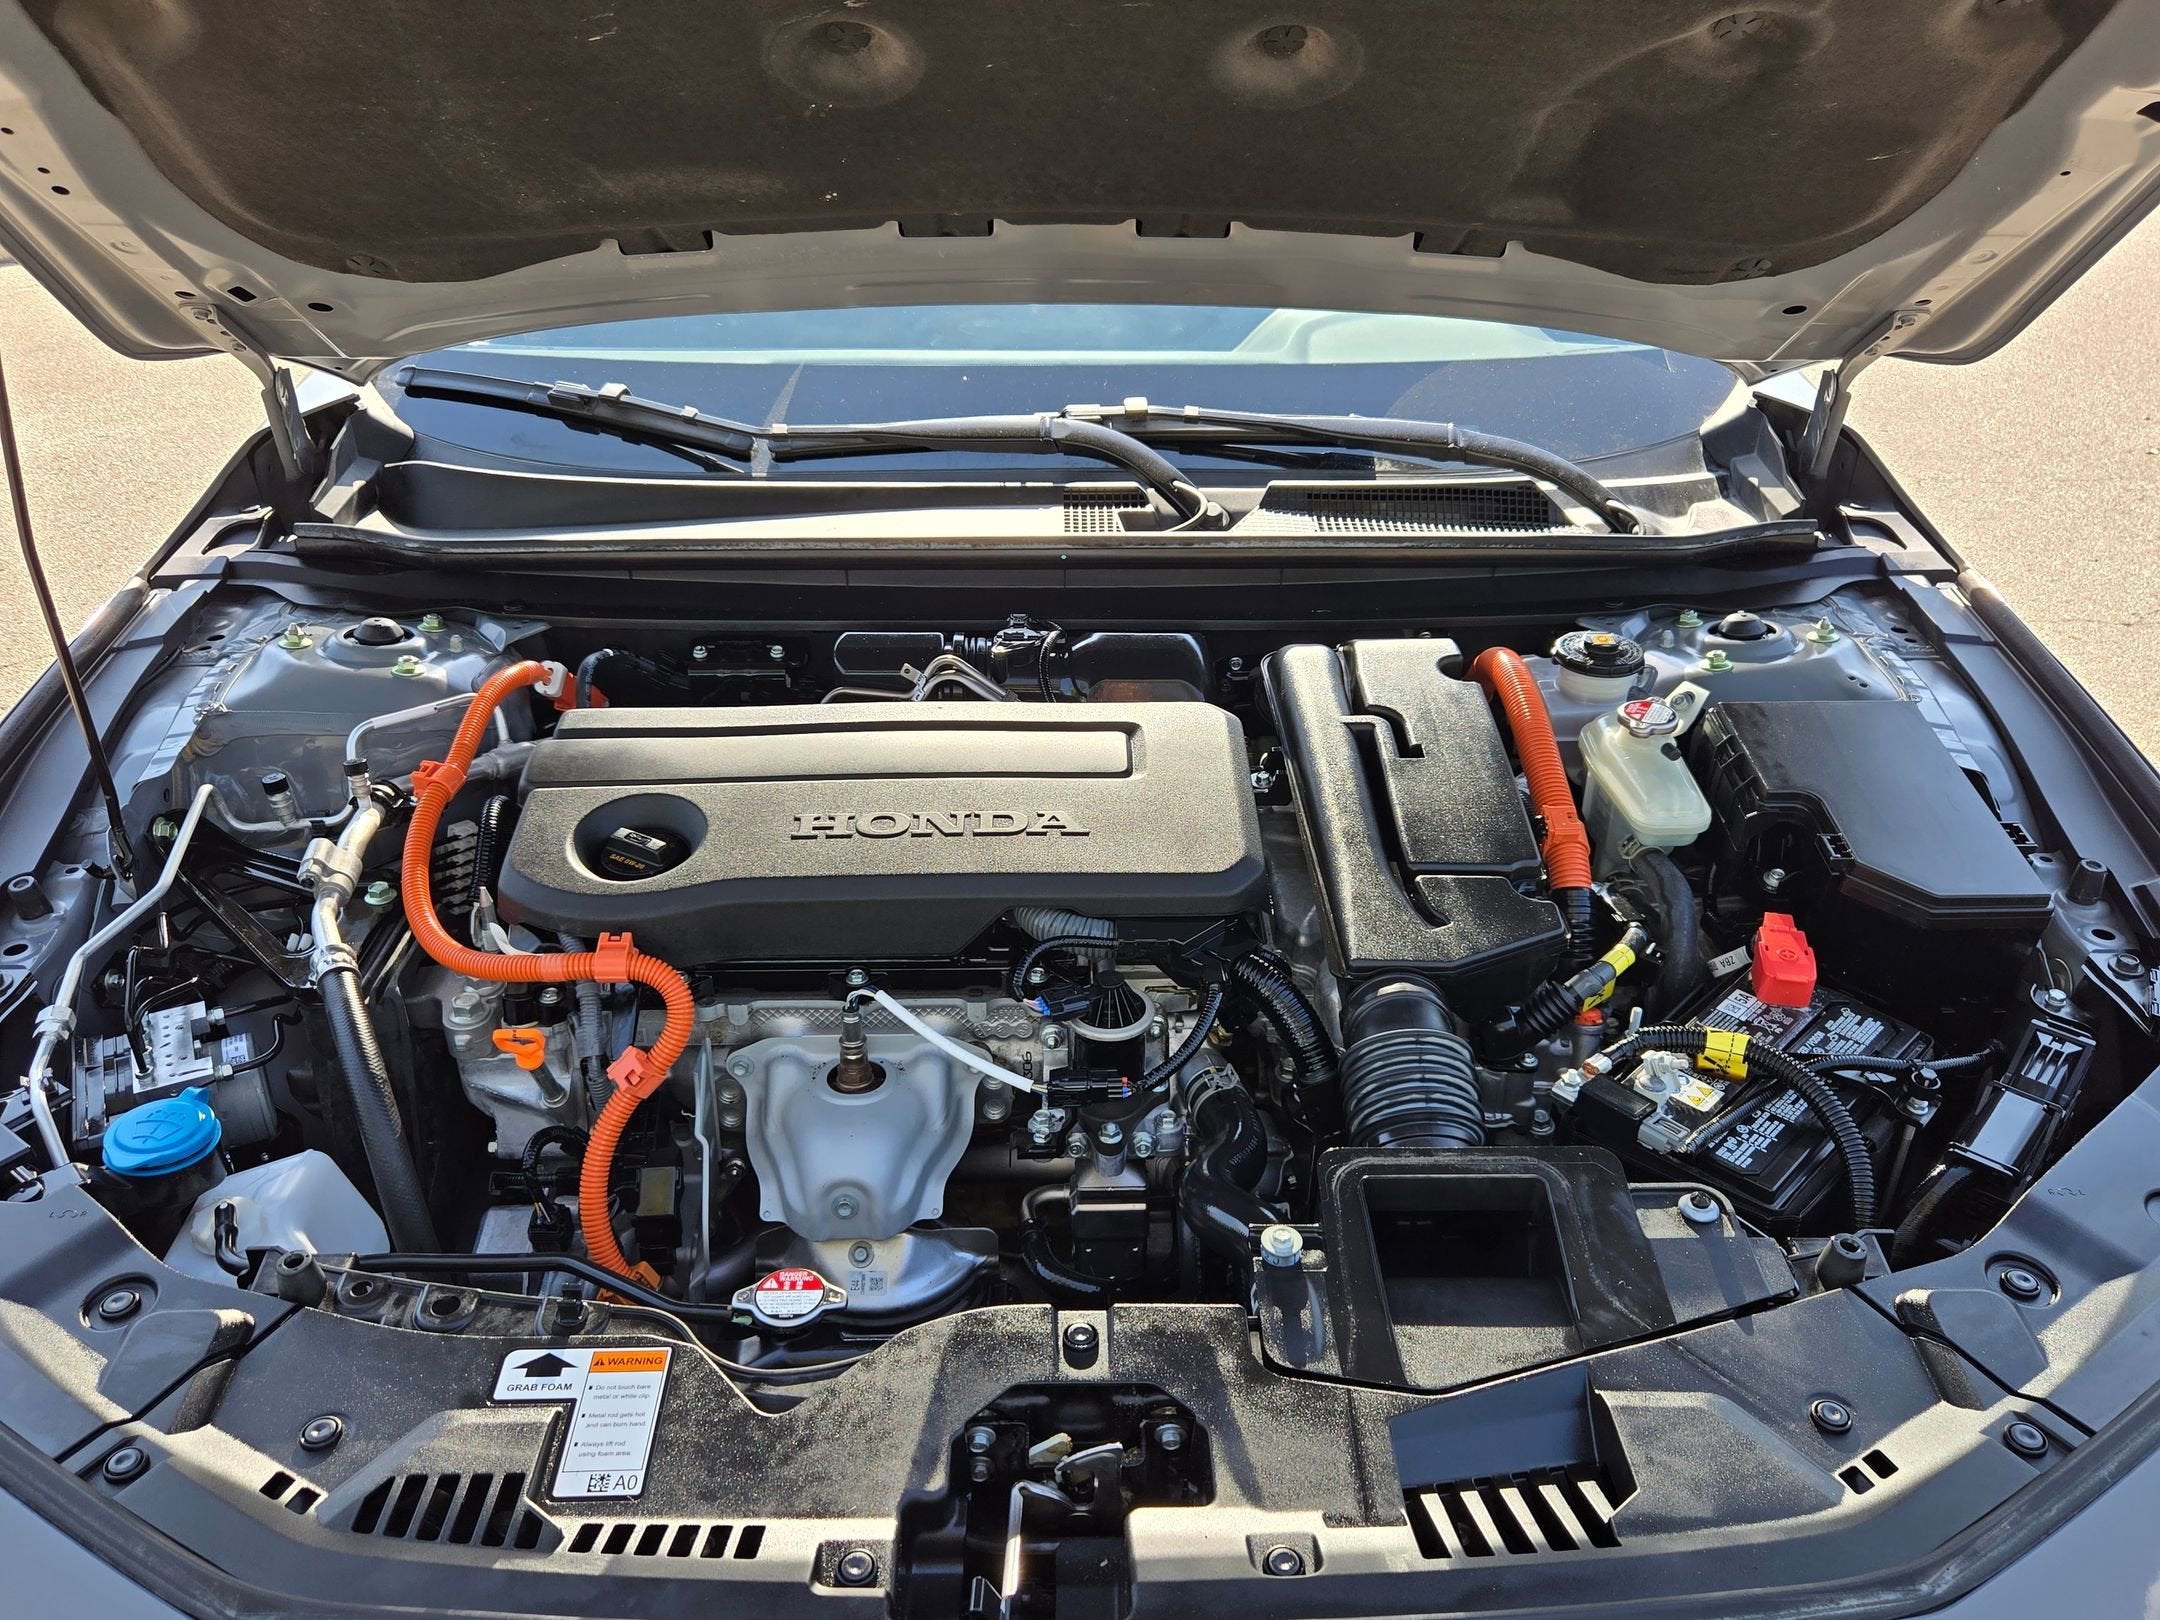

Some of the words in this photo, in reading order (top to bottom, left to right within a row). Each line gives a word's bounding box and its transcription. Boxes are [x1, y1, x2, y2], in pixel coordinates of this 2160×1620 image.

[790, 809, 1091, 840] HONDA
[609, 853, 624, 862] SAE
[624, 858, 646, 869] 0W-20
[1734, 993, 1753, 1005] 5A
[608, 1357, 663, 1366] WARNING
[506, 1383, 537, 1392] GRAB
[540, 1383, 573, 1391] FOAM
[613, 1474, 638, 1491] A0
